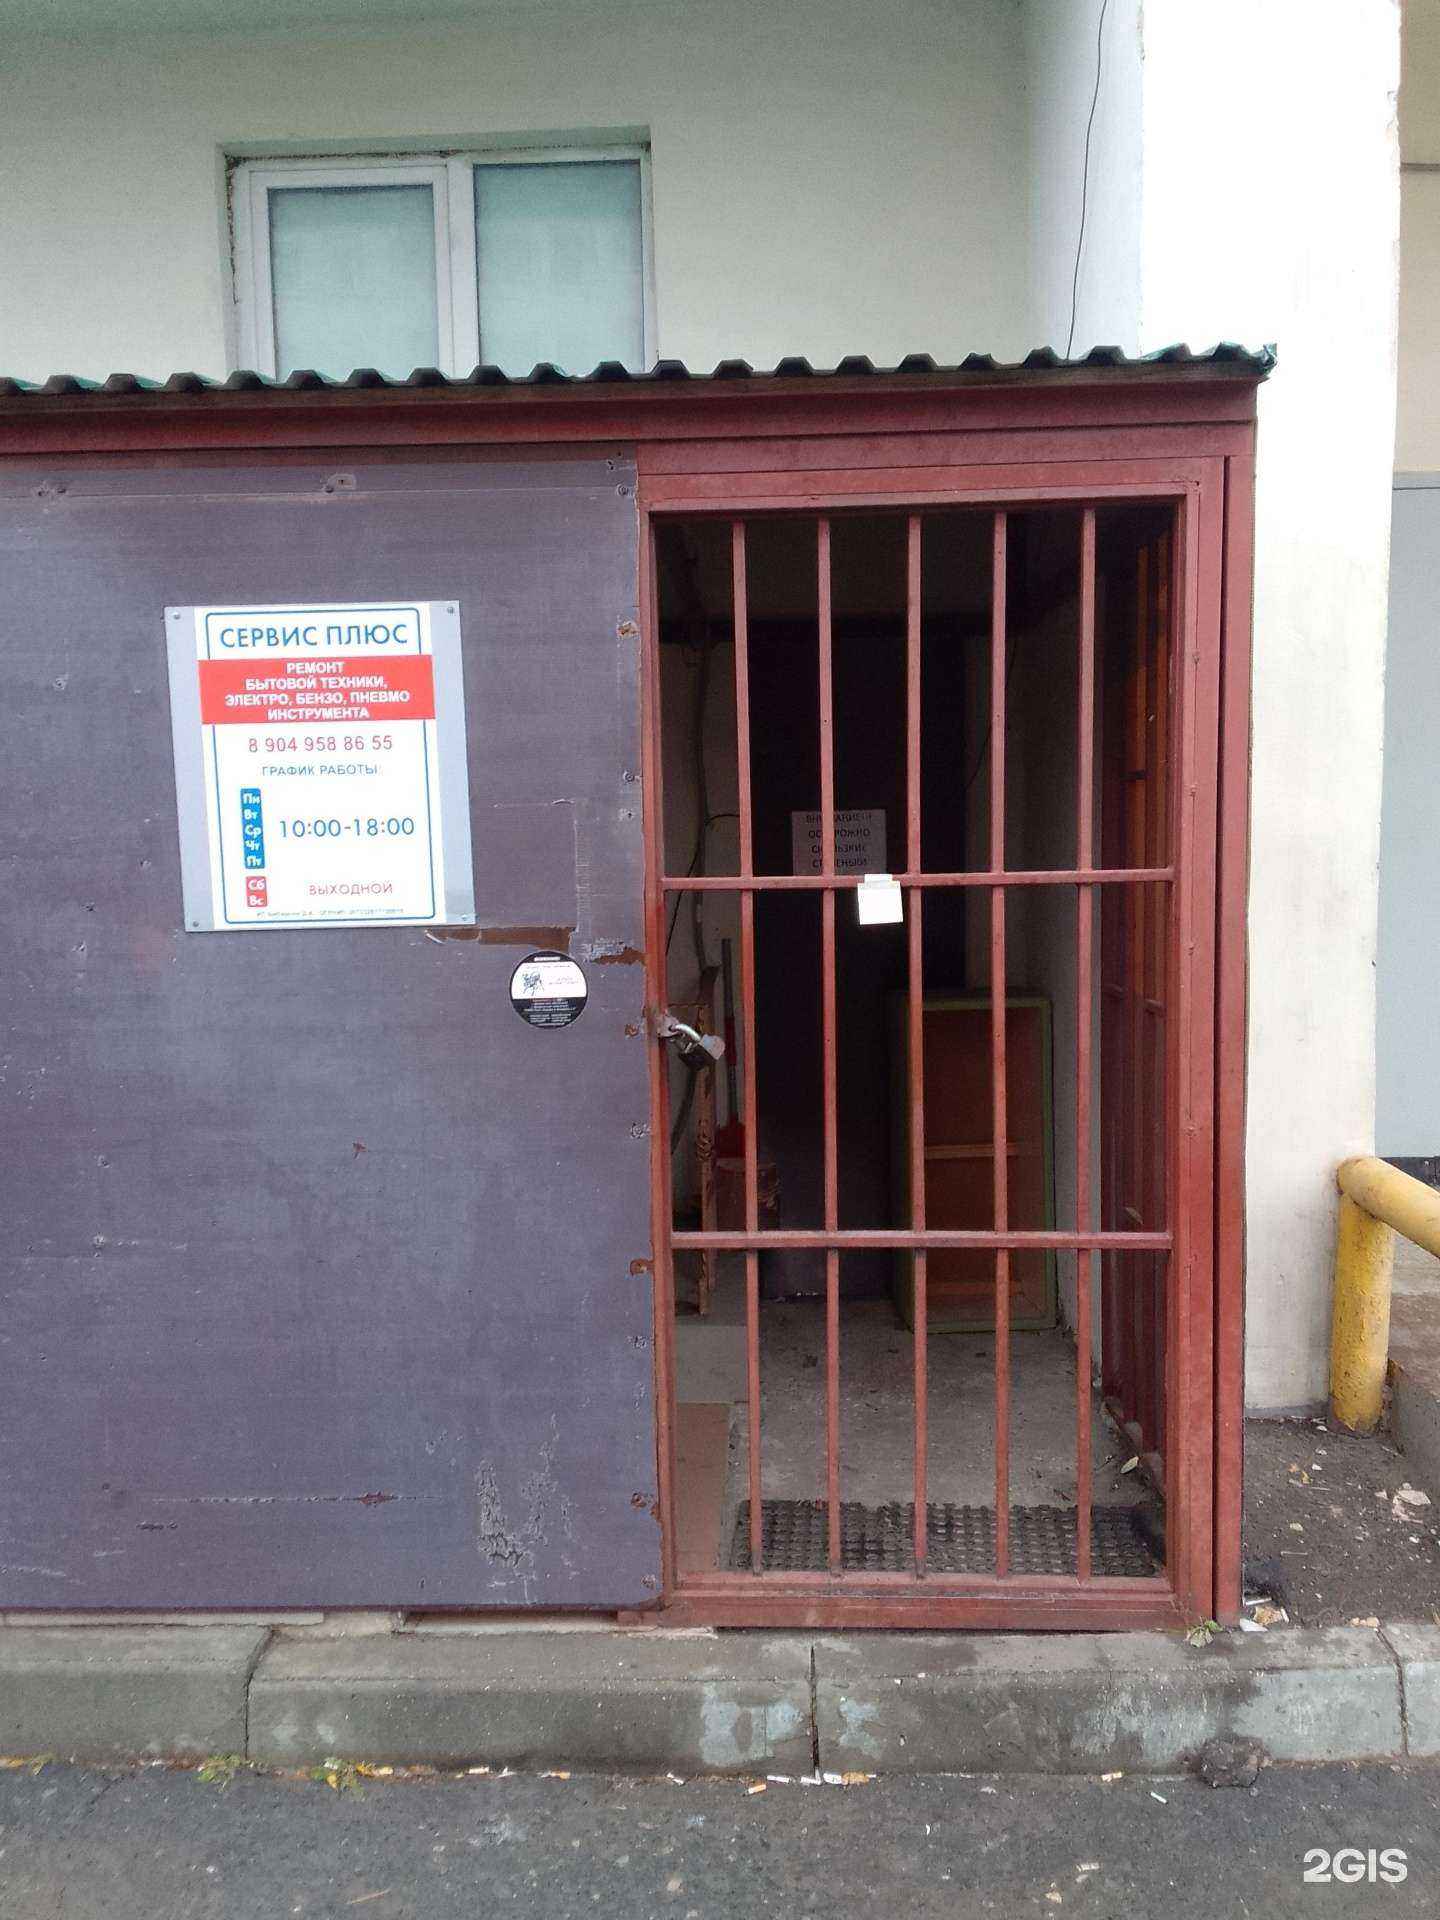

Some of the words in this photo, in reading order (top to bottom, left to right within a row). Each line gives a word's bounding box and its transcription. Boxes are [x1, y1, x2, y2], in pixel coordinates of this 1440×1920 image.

[220, 625, 317, 648] СЕРВИС
[327, 623, 408, 645] ПЛЮС
[286, 661, 345, 674] РЕМОНТ
[245, 676, 316, 691] БЫТОВОЙ
[319, 675, 388, 689] ТЕХНИКИ,
[225, 692, 293, 707] ЭЛЕКТРО,
[296, 691, 347, 706] БЕНЗО,
[351, 690, 410, 703] ПНЕВМО
[267, 707, 370, 721] ИНСТРУМЕНТА
[248, 738, 258, 753] 8
[265, 737, 298, 752] 904
[304, 736, 336, 751] 958
[344, 735, 365, 751] 86
[372, 734, 393, 750] 55
[262, 765, 315, 777] ГРАФИК
[243, 793, 260, 804] Пн
[244, 809, 258, 820] Вт
[245, 826, 261, 838] Ср
[279, 817, 415, 838] 10:00-18:00
[245, 840, 260, 851] Чт
[246, 856, 262, 867] Пт
[248, 879, 265, 890] Сб
[309, 882, 393, 896] ВЫХОДНОЙ
[248, 895, 264, 906] Вс
